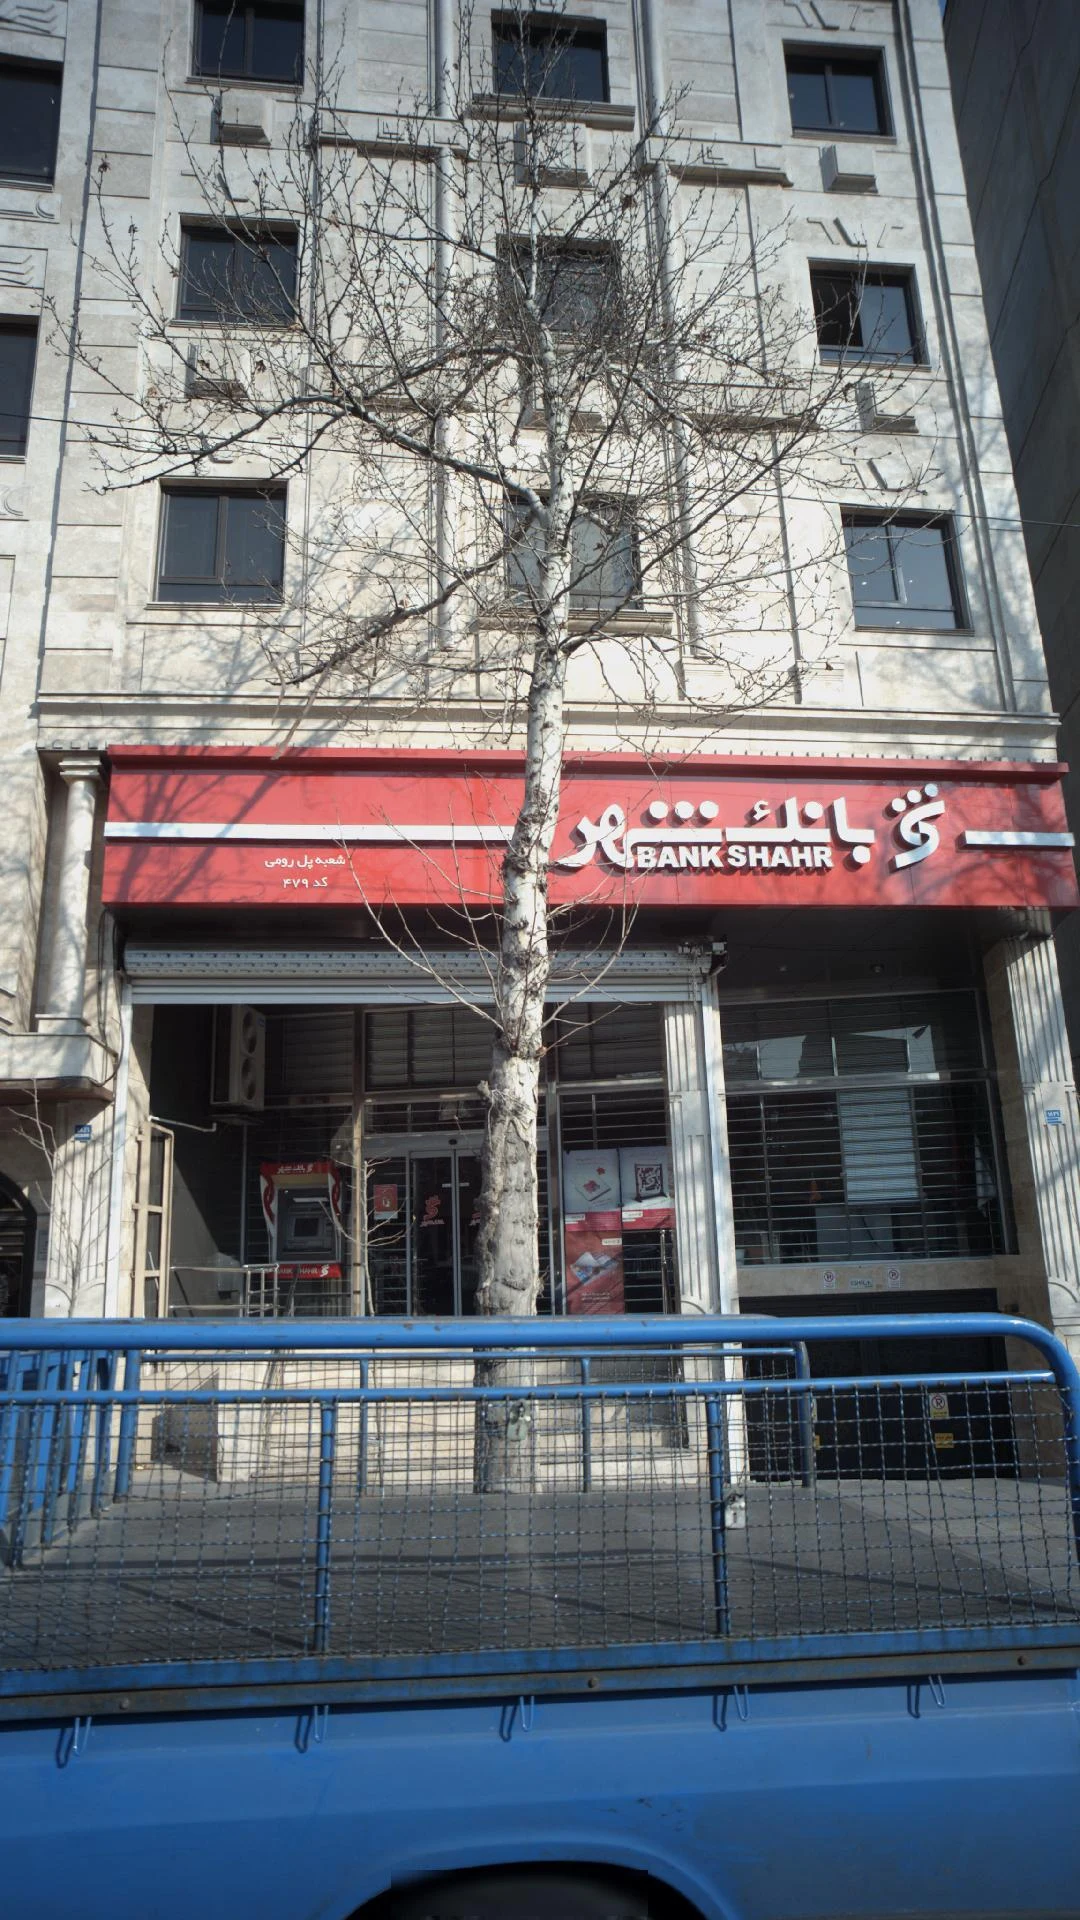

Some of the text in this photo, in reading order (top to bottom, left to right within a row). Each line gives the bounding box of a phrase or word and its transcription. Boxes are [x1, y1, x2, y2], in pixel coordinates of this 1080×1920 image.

[554, 799, 723, 868] شهر
[264, 854, 346, 870] شعبه پل رومی
[637, 845, 833, 868] BANK SHAHR
[282, 876, 329, 889] کد ۴۷۹
